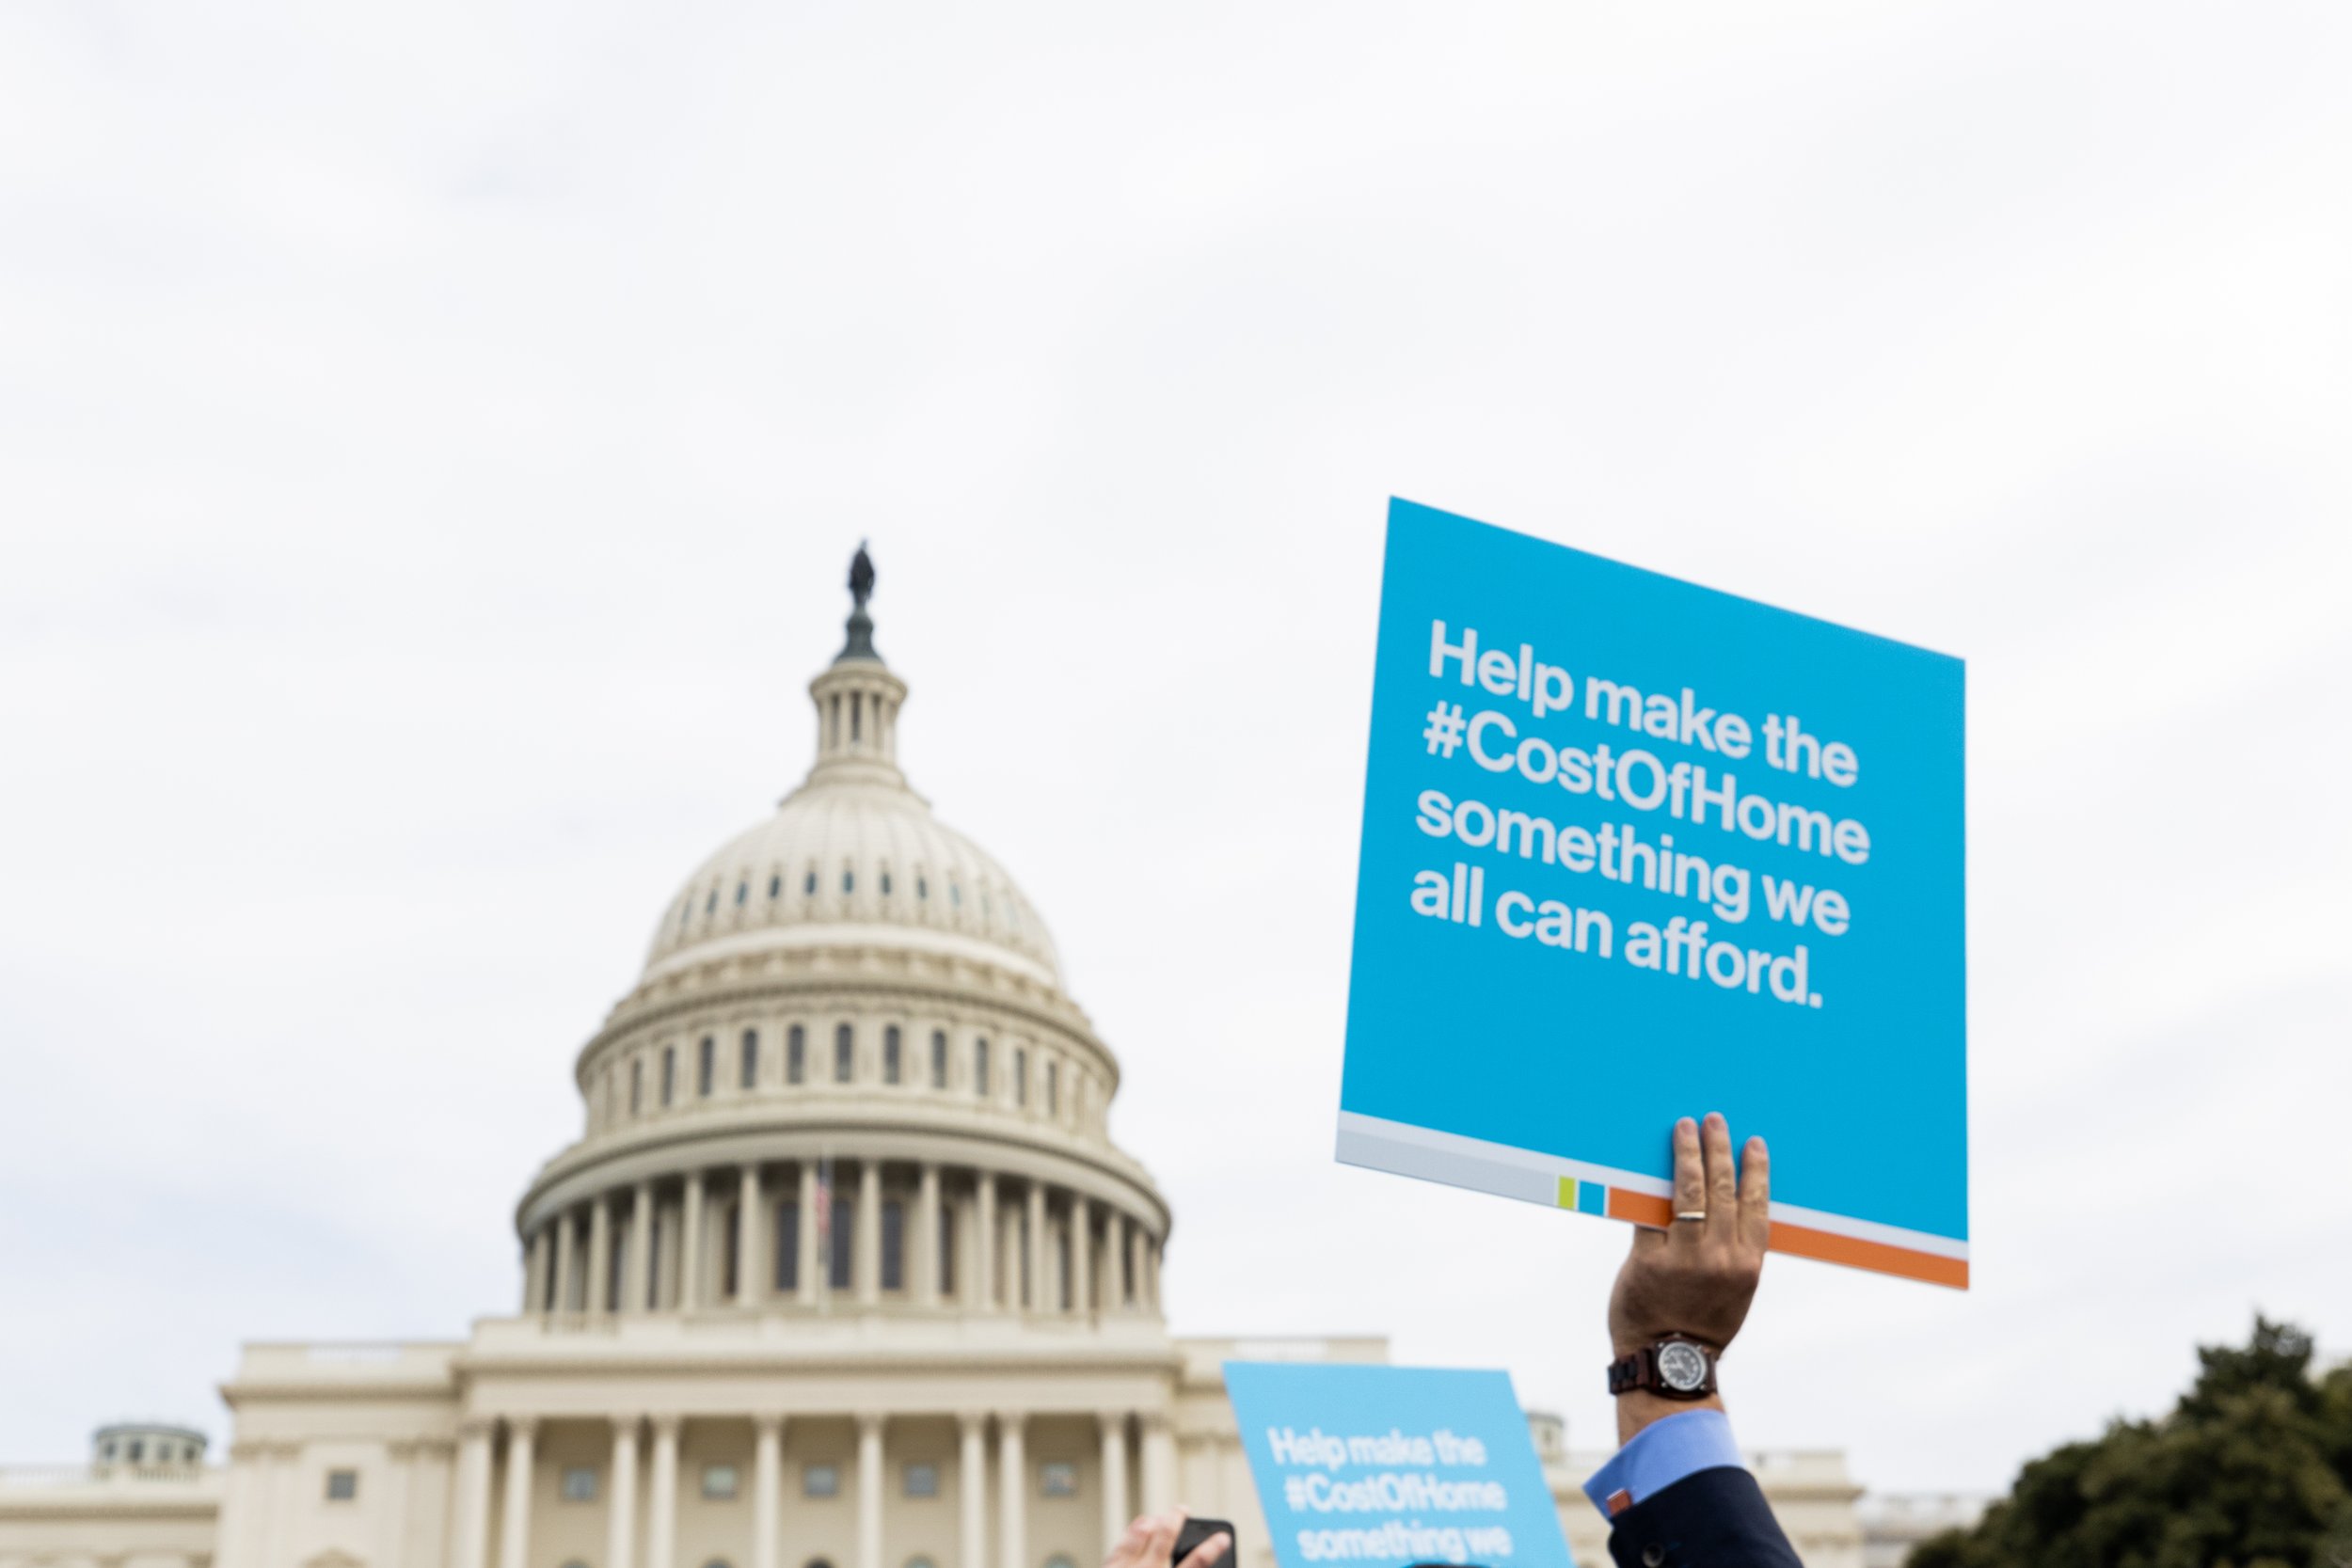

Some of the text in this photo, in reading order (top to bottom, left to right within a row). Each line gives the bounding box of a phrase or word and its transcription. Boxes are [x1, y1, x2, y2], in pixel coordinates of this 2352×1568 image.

[1429, 619, 1859, 787] Help make the
[1422, 700, 1870, 864] #CostOfHome
[1410, 862, 1823, 1008] all can afford.
[1416, 789, 1851, 936] something we
[1267, 1427, 1486, 1472] Help make the
[1284, 1472, 1507, 1513] #CostOfHome
[1296, 1518, 1513, 1563] something we
